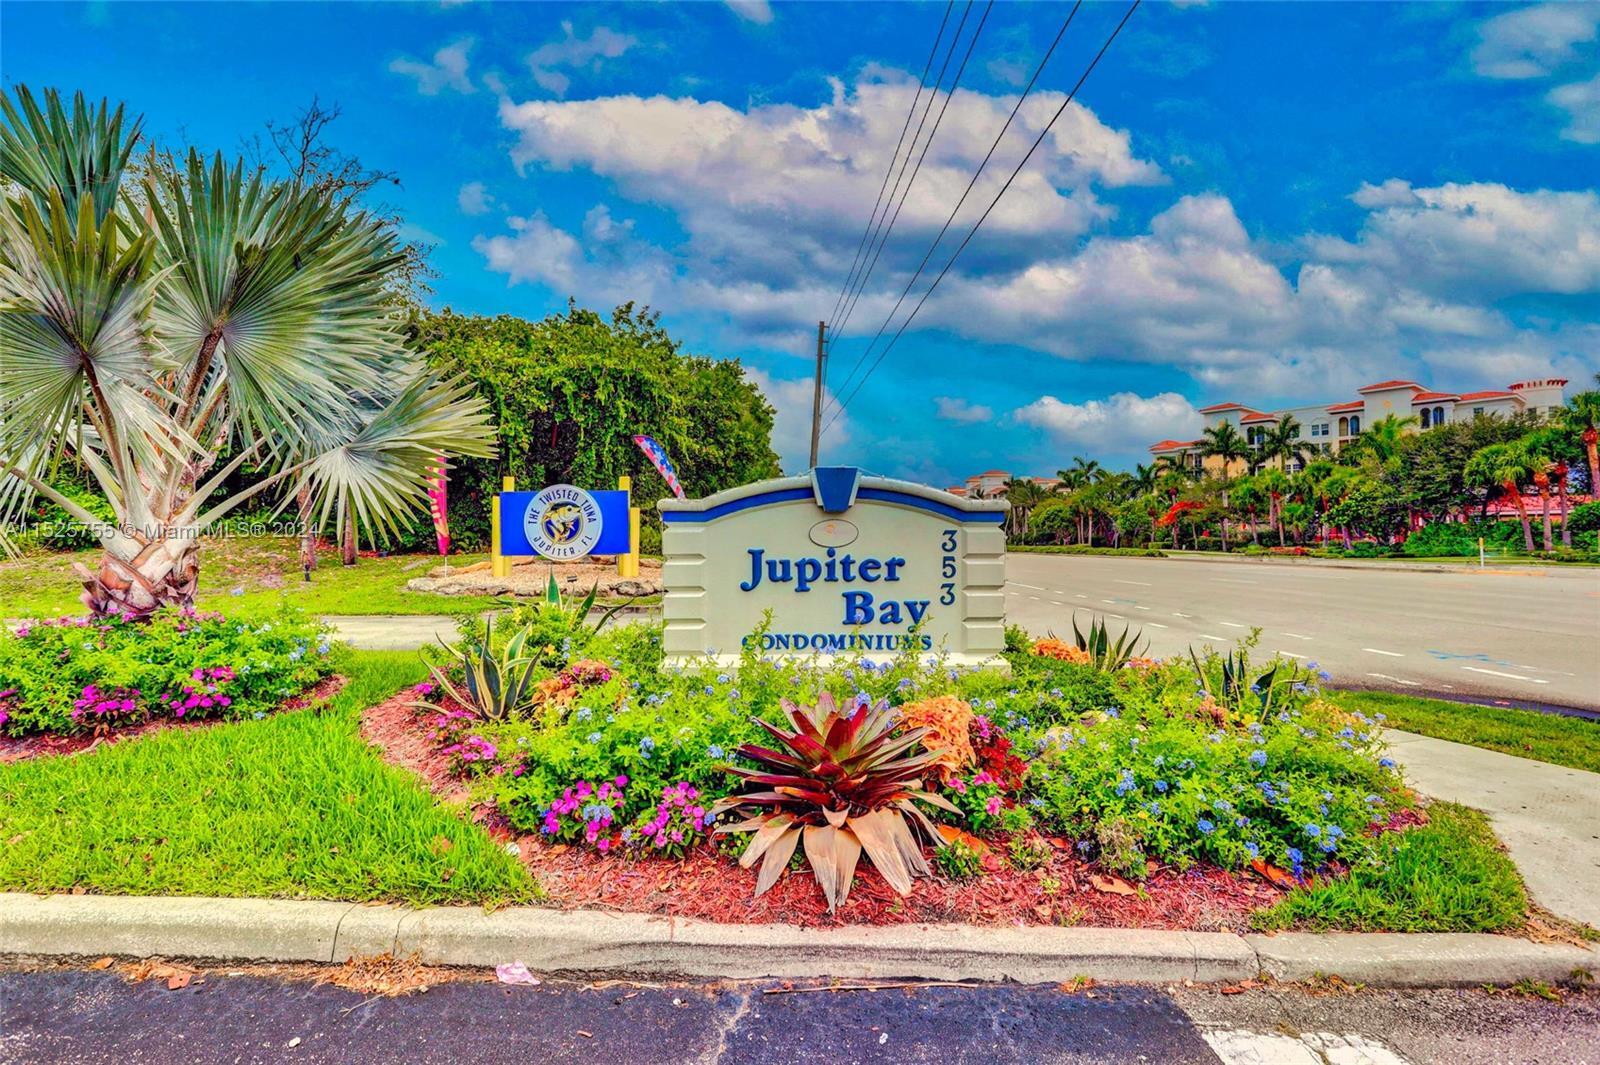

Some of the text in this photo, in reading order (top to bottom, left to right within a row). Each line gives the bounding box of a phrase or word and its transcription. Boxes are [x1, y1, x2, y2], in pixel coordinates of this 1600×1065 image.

[528, 490, 597, 525] THE TWISTED TUNA
[581, 535, 593, 547] FL
[740, 547, 906, 593] Jupiter
[842, 591, 931, 634] Bay
